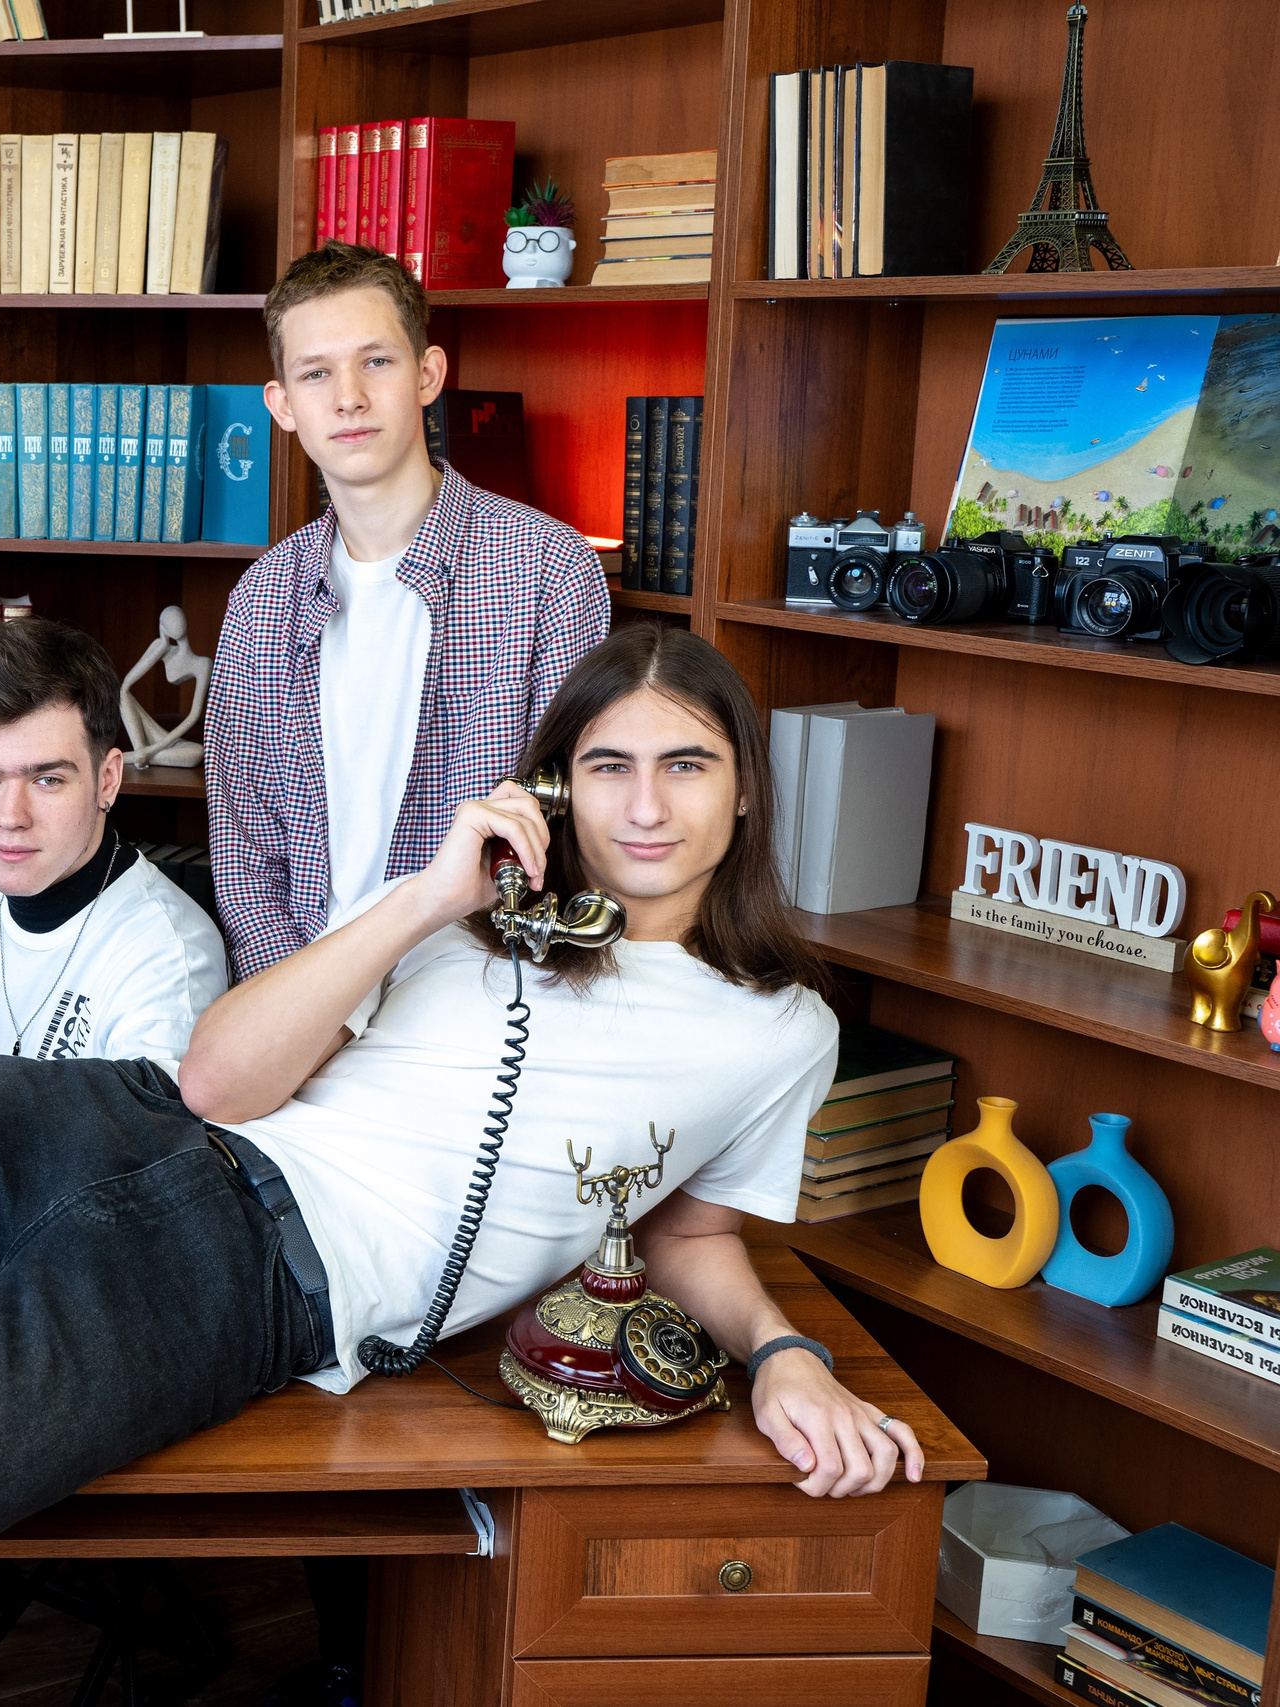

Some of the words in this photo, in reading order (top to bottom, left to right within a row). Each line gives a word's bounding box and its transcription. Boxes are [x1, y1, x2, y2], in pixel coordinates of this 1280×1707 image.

[6, 177, 14, 227] ФАНТАСТИКА
[60, 176, 69, 226] ФАНТАСТИКА
[6, 228, 14, 278] ЗАРУБЕЖНАЯ
[57, 227, 66, 278] ЗАРУБЕЖНАЯ
[1008, 348, 1059, 362] ЦУНАМИ
[629, 414, 640, 431] 6
[103, 454, 109, 462] 6
[967, 545, 996, 554] YASHICA
[1074, 556, 1090, 566] 122
[1115, 548, 1156, 558] ZENIT
[958, 822, 1187, 938] FRIEND
[970, 903, 982, 918] is
[985, 908, 1008, 925] the
[1010, 913, 1055, 940] family
[1056, 929, 1084, 944] you
[1087, 929, 1147, 960] choose.
[1193, 1255, 1274, 1281] ФРЕДЕРИК
[1230, 1267, 1269, 1281] ПОЛ
[1179, 1293, 1264, 1335] ВСЕЛЕННОЙ
[1171, 1322, 1254, 1365] ВСЕЛЕННОЙ
[1096, 1617, 1143, 1646] КОММАНДО
[1145, 1645, 1189, 1673] МАККЕННЫ
[1153, 1641, 1185, 1662] ЗОЛОТО
[1195, 1664, 1215, 1681] МЫС
[1216, 1676, 1249, 1698] СТРАХА
[1087, 1684, 1116, 1707] ТАНЦЫ
